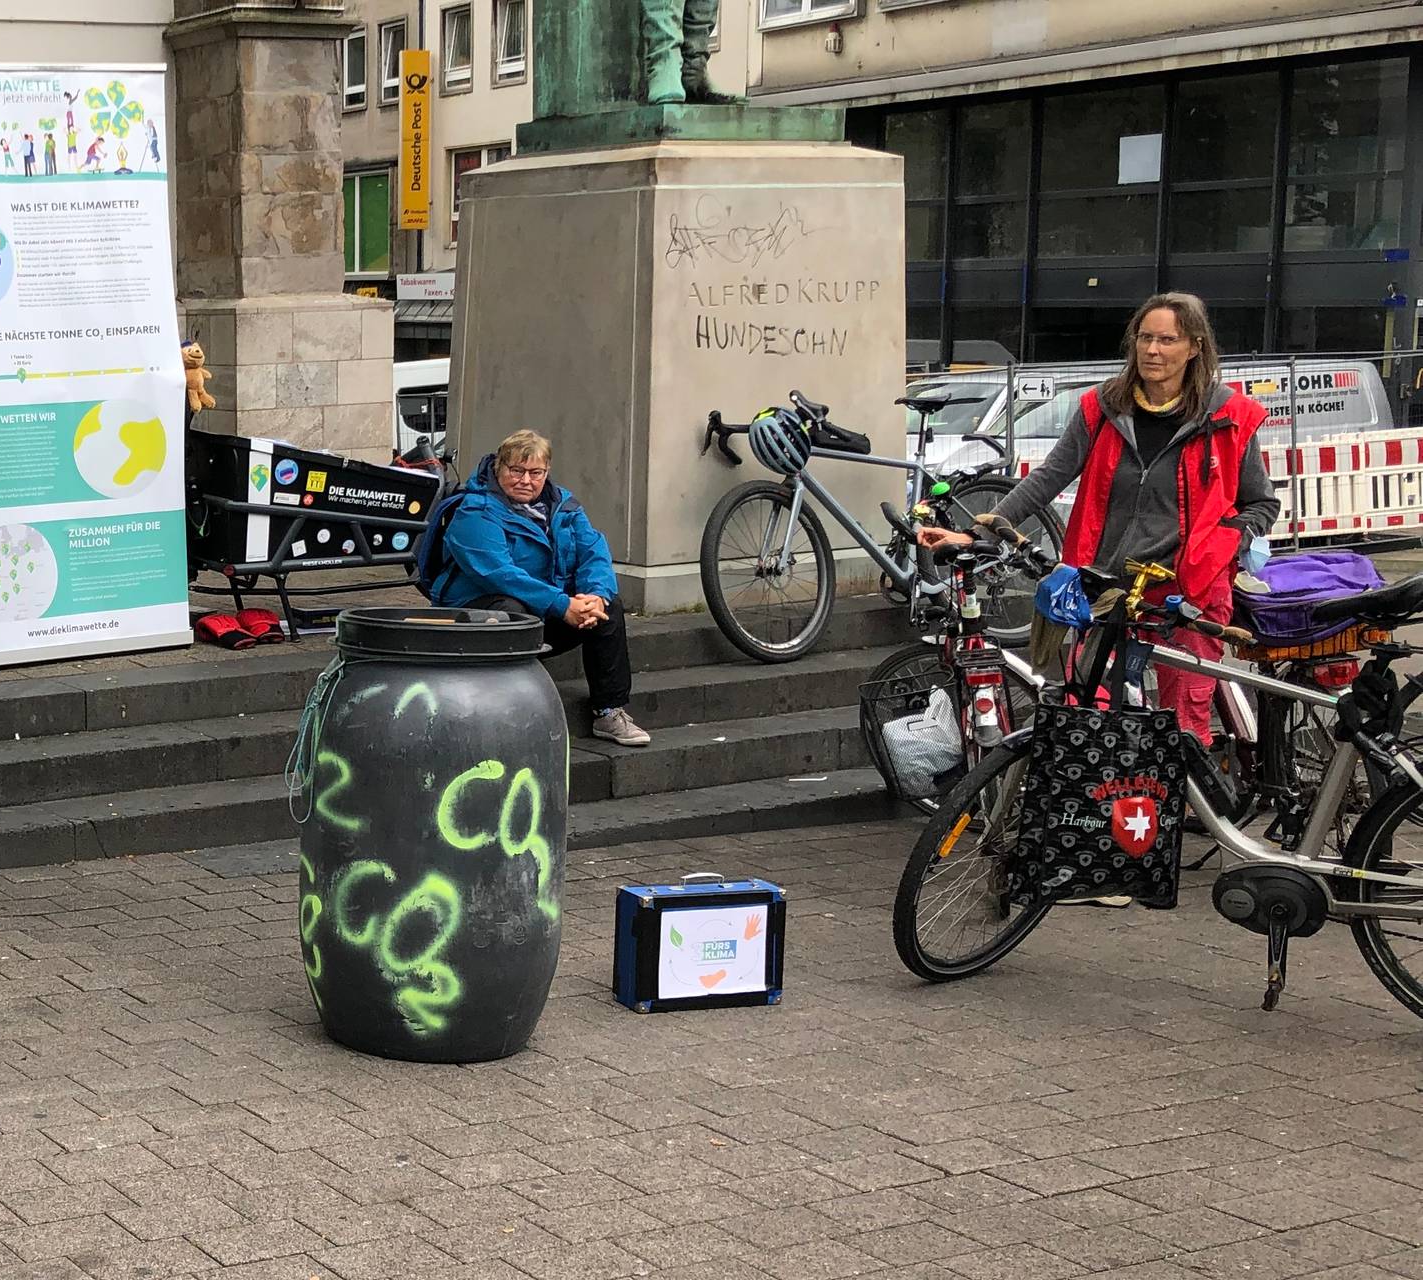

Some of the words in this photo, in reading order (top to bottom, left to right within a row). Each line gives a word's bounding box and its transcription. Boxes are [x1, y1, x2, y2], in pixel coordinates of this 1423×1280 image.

[411, 102, 422, 129] Post
[411, 132, 422, 191] Deutsche
[10, 202, 32, 213] WAS
[34, 202, 49, 212] IST
[51, 202, 68, 212] DIE
[70, 200, 139, 212] KLIMAWETTE?
[689, 281, 790, 307] ALFRED
[798, 278, 881, 303] KRUPP
[5, 328, 47, 341] NÄCHSTE
[48, 329, 84, 340] TONNE
[106, 325, 161, 337] EINSPAREN
[695, 315, 848, 357] HUNDESOHN
[1245, 374, 1333, 395] E-FOHR
[1308, 400, 1345, 416] KÖCHE!
[0, 413, 37, 424] WETTEN
[39, 412, 57, 422] WIR
[328, 485, 345, 496] DIE
[346, 488, 406, 503] KLIMAWETTE
[367, 498, 380, 507] jetzt
[381, 500, 405, 510] einfach!
[68, 525, 124, 538] ZUSAMMEN
[126, 521, 143, 533] FÜR
[145, 521, 161, 531] DIE
[69, 537, 111, 549] MILLION
[27, 620, 120, 638] www.dieklimawette.de
[1061, 812, 1107, 829] Harbour
[705, 940, 731, 951] FÜRS
[705, 950, 735, 959] KLIMA
